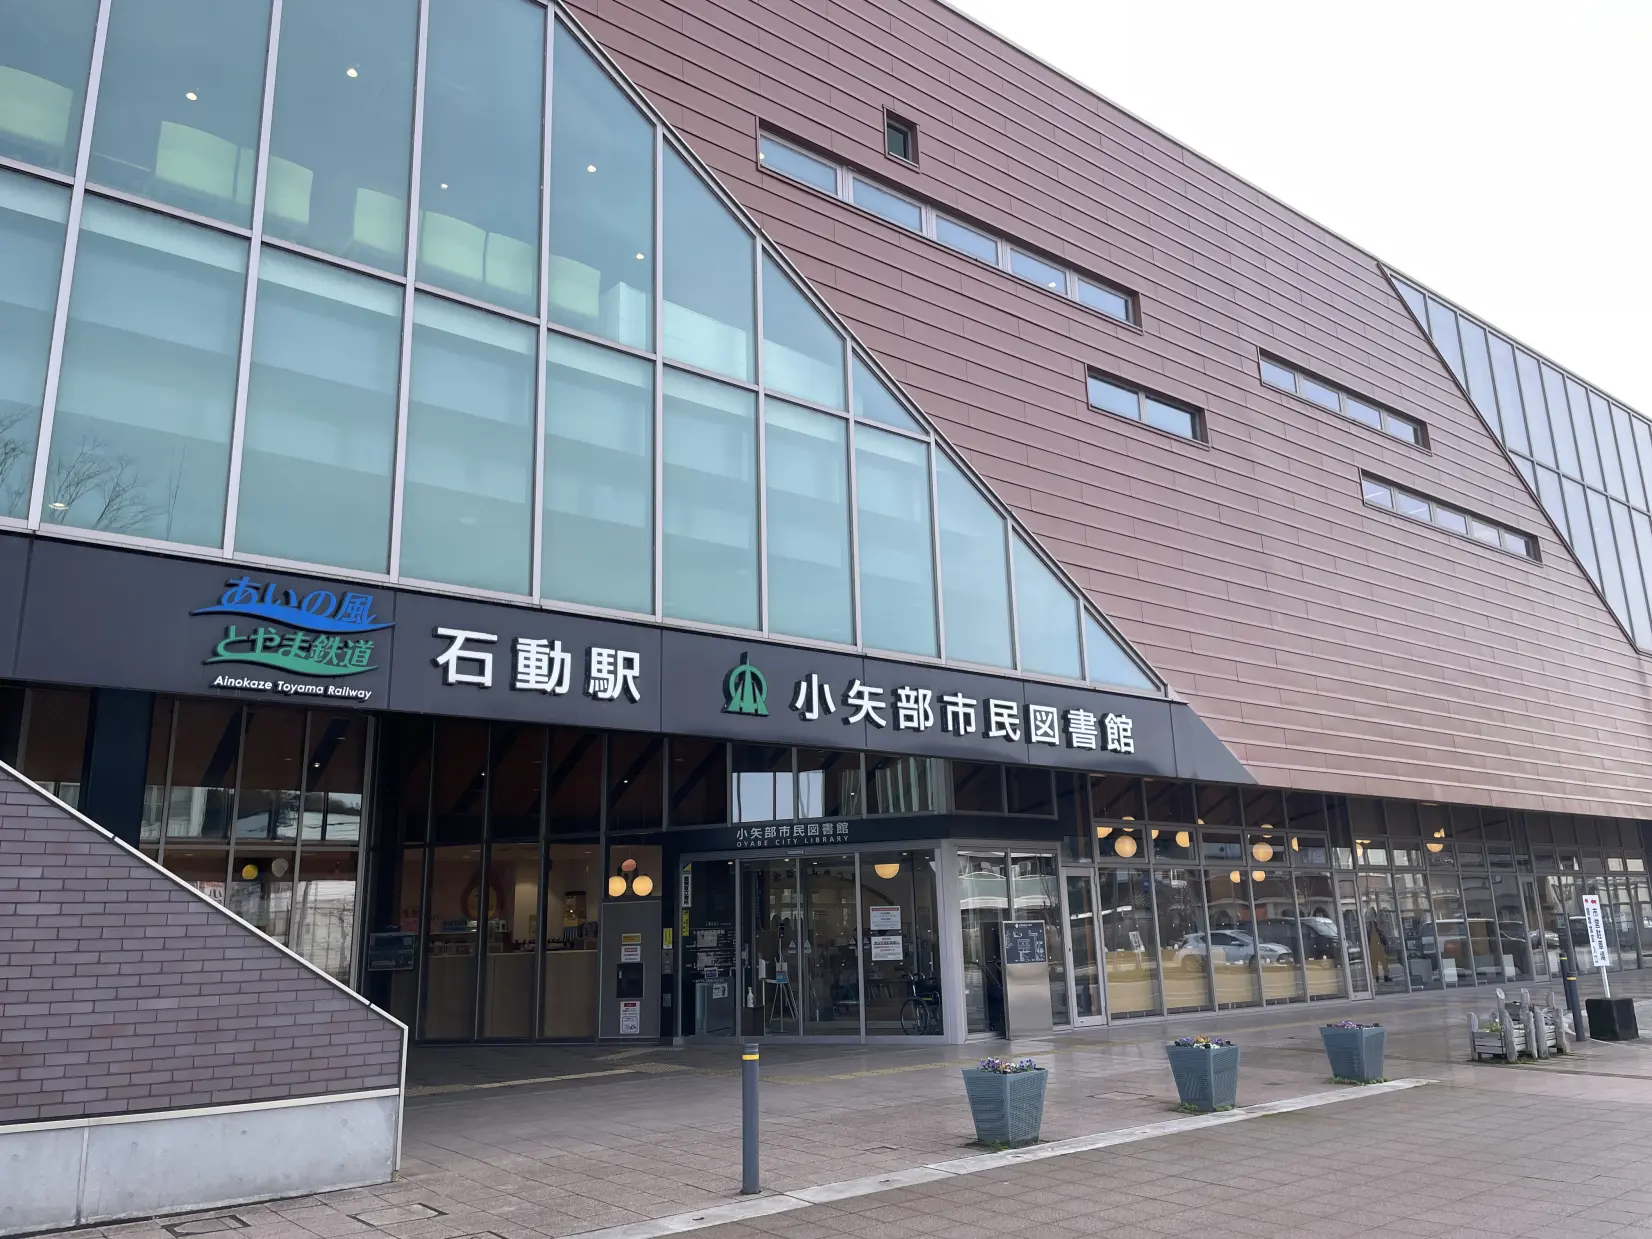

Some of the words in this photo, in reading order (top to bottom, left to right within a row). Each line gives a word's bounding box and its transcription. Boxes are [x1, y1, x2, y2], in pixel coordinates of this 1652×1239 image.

[220, 576, 377, 625] あいの風
[216, 625, 375, 667] とやま鉄道
[436, 627, 641, 701] 石動駅
[213, 675, 273, 690] Ainokaze
[277, 681, 324, 694] Toyama
[327, 685, 372, 700] Railway
[795, 673, 1135, 754] 小矢部市民図書館
[736, 822, 849, 840] 小矢部市民図書館
[736, 839, 769, 848] OYABE
[775, 838, 798, 846] CITY
[804, 835, 849, 844] LIBRARY
